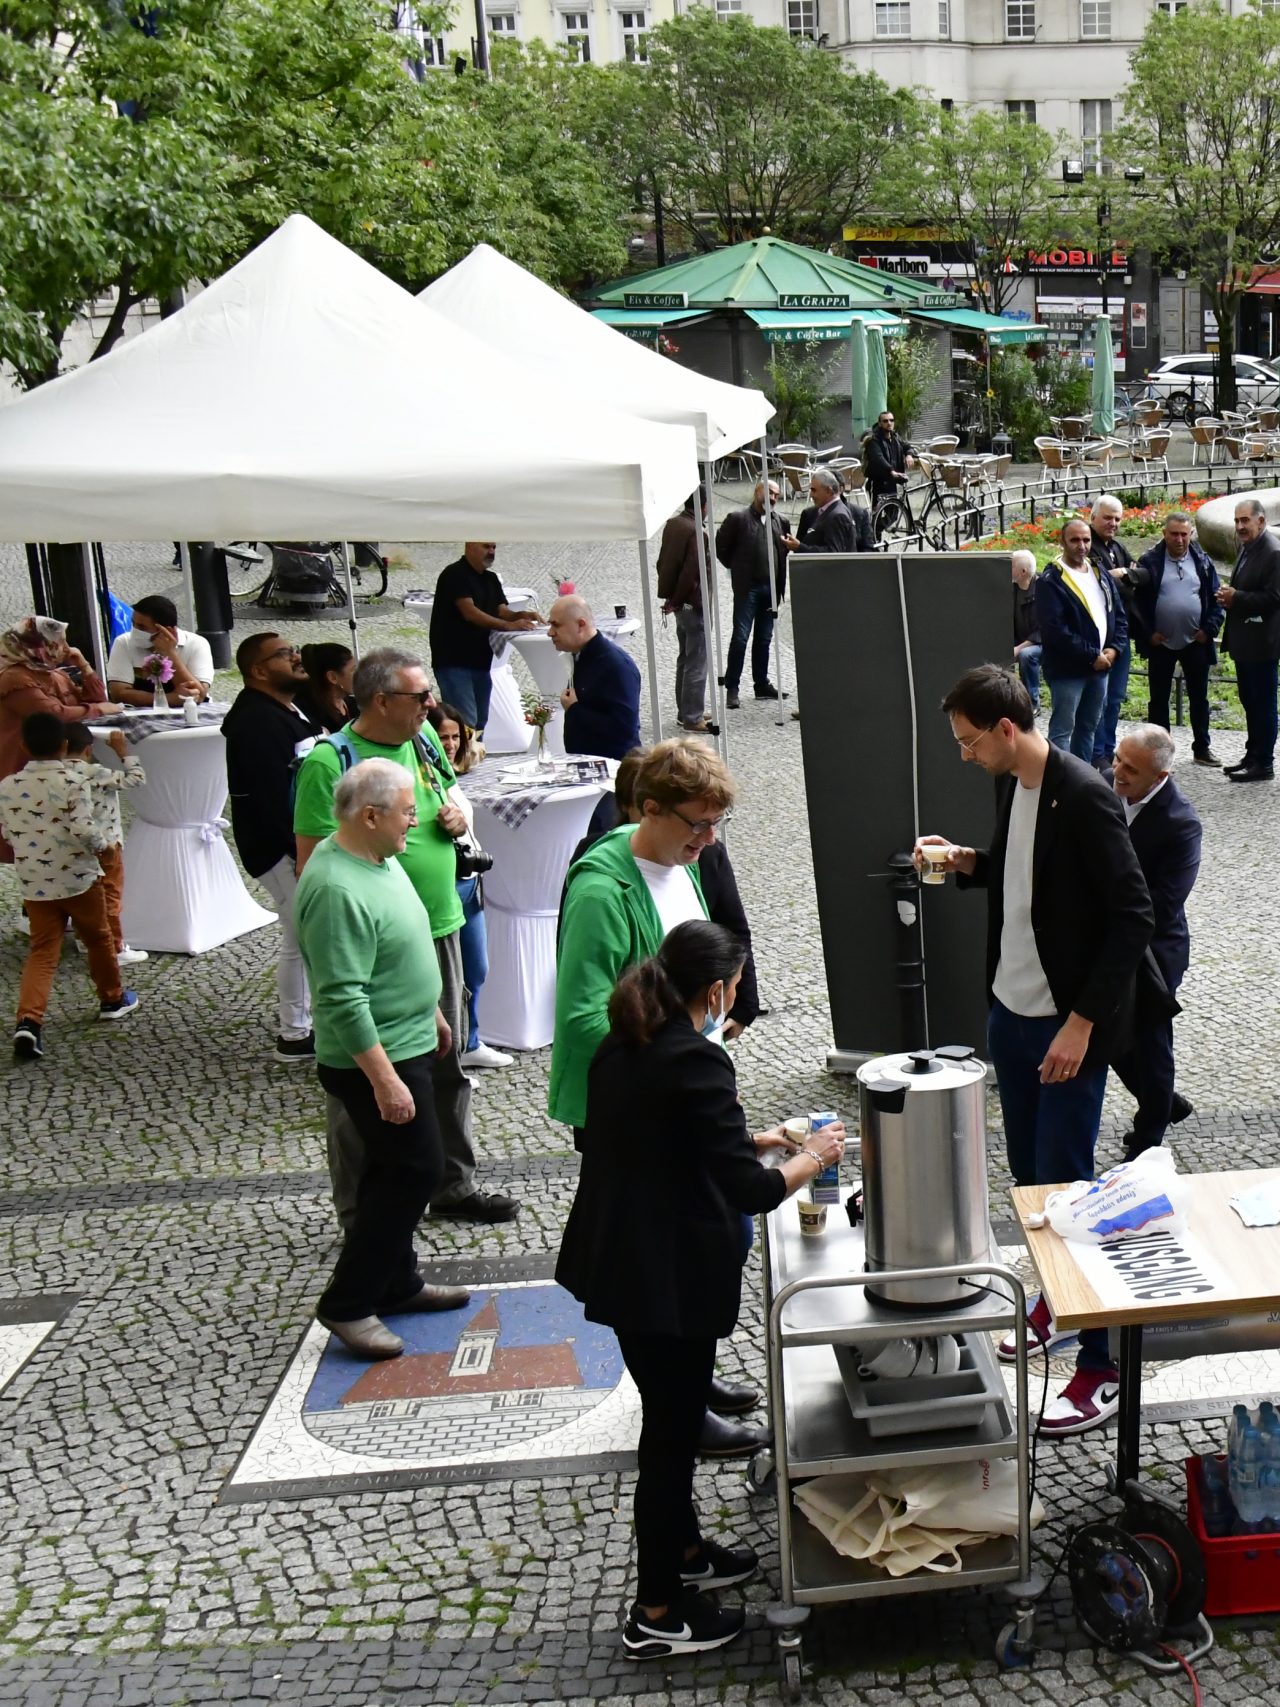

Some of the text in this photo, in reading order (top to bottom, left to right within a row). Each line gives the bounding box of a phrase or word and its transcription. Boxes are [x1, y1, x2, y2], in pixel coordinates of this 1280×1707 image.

[878, 257, 929, 274] Marlboro
[628, 295, 681, 307] Eis & Coffee
[783, 295, 847, 307] LA GRAPPA
[925, 295, 956, 307] Eis & Coffee
[785, 331, 793, 340] &
[825, 329, 841, 338] Bar
[1207, 1399, 1242, 1411] SEIT
